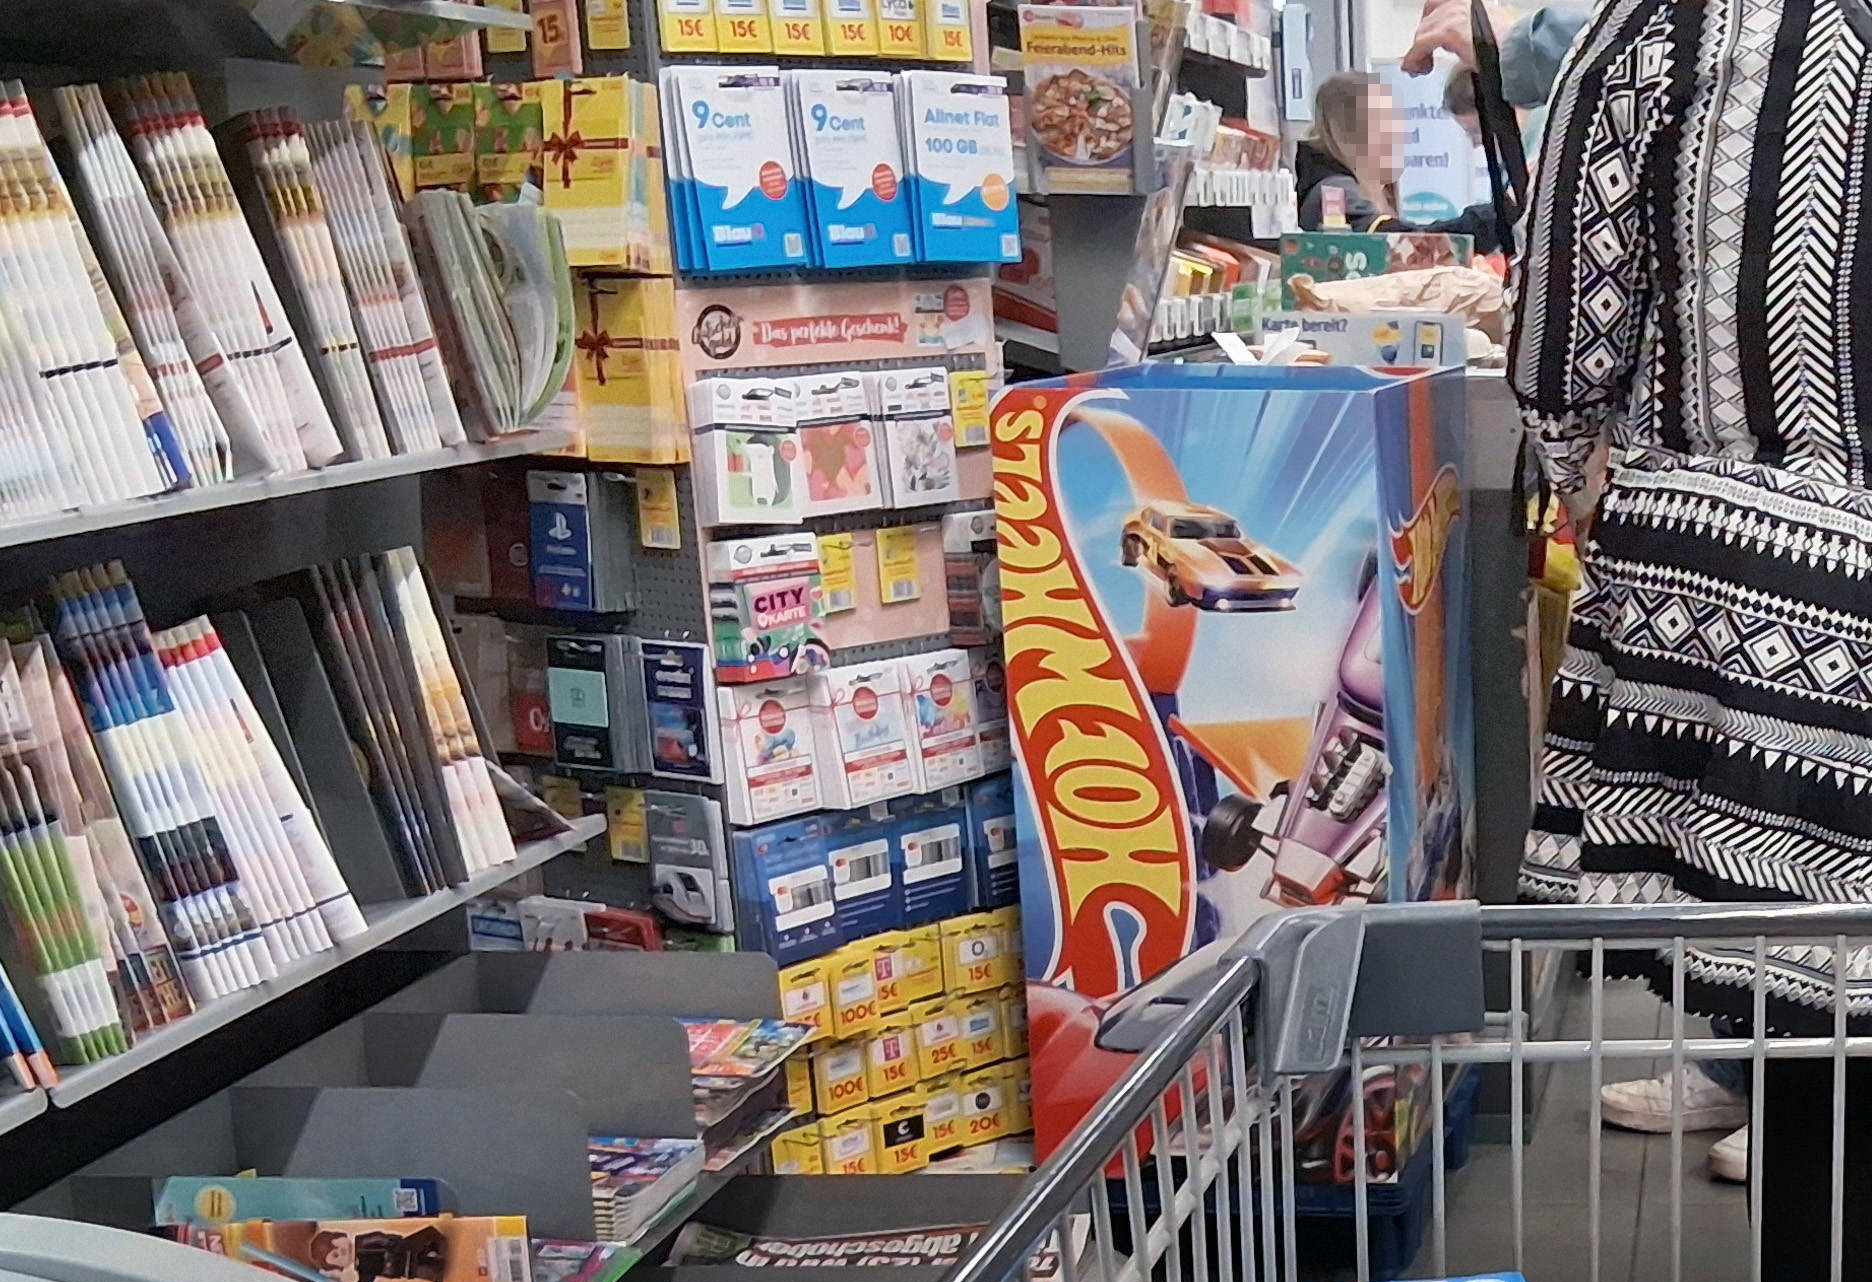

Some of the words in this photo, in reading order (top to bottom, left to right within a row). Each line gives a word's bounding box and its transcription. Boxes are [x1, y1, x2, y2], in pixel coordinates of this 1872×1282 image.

[679, 19, 703, 37] 15€
[731, 21, 757, 37] 15€
[785, 24, 810, 40] 15€
[840, 24, 866, 41] 15€
[889, 24, 912, 42] 10€
[943, 31, 962, 47] 15€
[692, 100, 710, 129] 9
[712, 112, 750, 128] Cent
[812, 104, 828, 131] 9
[829, 117, 865, 131] Cent
[925, 107, 970, 125] Allnet
[975, 107, 999, 125] Flat
[926, 139, 953, 153] 100
[957, 139, 978, 154] GB
[761, 324, 788, 343] Das
[1302, 318, 1348, 332] bereit?
[992, 408, 1142, 743] WHEELS
[754, 587, 804, 613] CITY
[767, 606, 807, 625] KARTE
[1043, 719, 1183, 918] HOT
[968, 964, 991, 981] 15€
[841, 1001, 876, 1024] 100€
[931, 1043, 958, 1064] 25€
[883, 1066, 905, 1081] 15€
[828, 1077, 863, 1099] 100€
[969, 1114, 999, 1134] 20€
[894, 1145, 917, 1163] 15€
